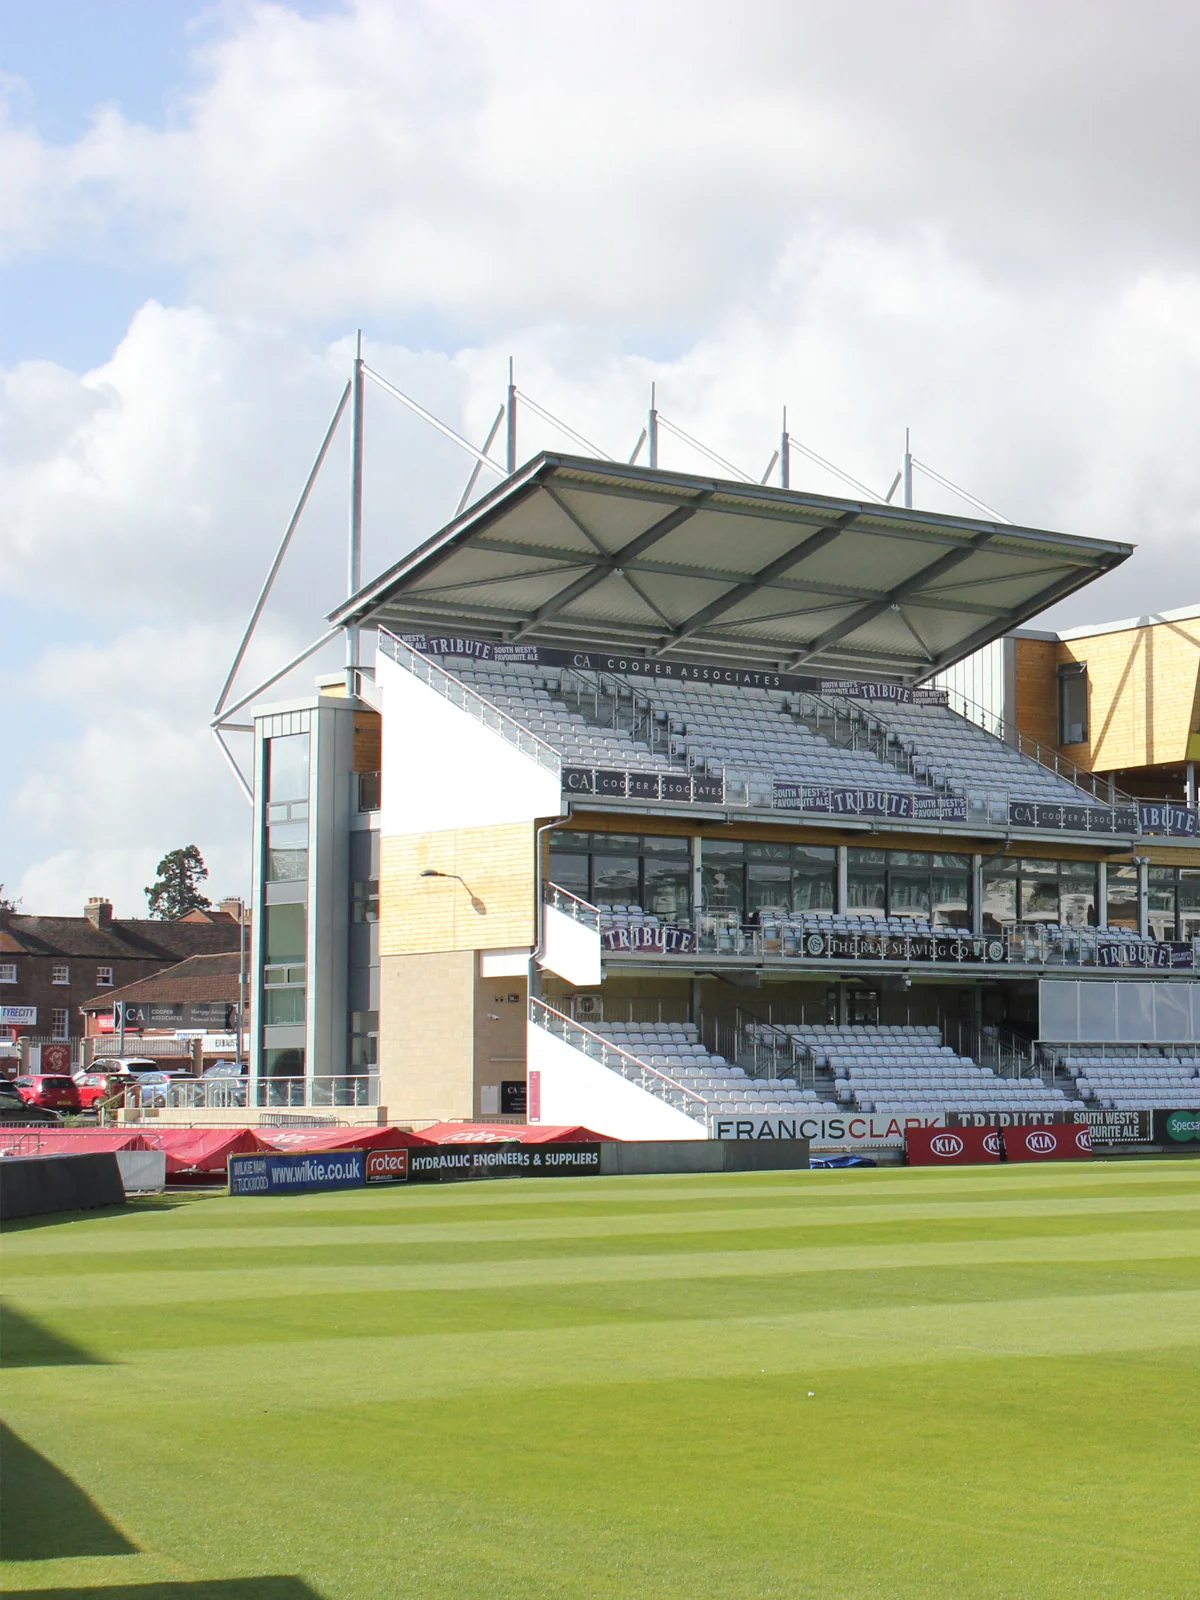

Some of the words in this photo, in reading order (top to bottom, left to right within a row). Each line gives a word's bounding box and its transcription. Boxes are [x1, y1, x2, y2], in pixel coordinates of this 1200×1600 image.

[415, 641, 428, 650] ALE
[429, 638, 491, 660] TRIBUTE
[494, 653, 526, 661] FAVOURITE
[573, 654, 592, 668] CA
[607, 659, 672, 675] COOPER
[680, 667, 780, 686] ASSOCIATES
[861, 684, 910, 703] TRIBUTE
[568, 773, 590, 789] CA
[602, 779, 649, 790] COOPER
[652, 783, 722, 796] ASSOCIATES
[773, 788, 797, 798] SOUTH
[797, 787, 828, 797] WEST'S
[815, 797, 830, 806] ALE
[834, 791, 909, 816] TRIBUTE
[914, 800, 937, 809] SOUTH
[953, 807, 966, 816] ALE
[1014, 807, 1032, 821] CA
[1042, 812, 1079, 823] COOPER
[1081, 816, 1137, 826] ASSOCATES
[1143, 807, 1196, 833] IBUTE
[605, 926, 692, 951] TRIBUTE
[830, 940, 856, 953] THE
[860, 941, 890, 954] REAL
[892, 941, 947, 956] SHAVING
[1100, 945, 1167, 966] TRIBUTE
[125, 1008, 146, 1021] CA
[1073, 1112, 1104, 1125] SOUTH
[1105, 1111, 1140, 1125] WEST'S
[1088, 1125, 1121, 1138] OURITE
[1122, 1125, 1140, 1137] ALE
[935, 1139, 959, 1152] KIA
[1030, 1136, 1052, 1149] KIA
[370, 1154, 405, 1171] rotec
[412, 1154, 471, 1171] HYDRAULIC
[473, 1152, 530, 1167] ENGINEERS
[533, 1154, 542, 1166] &
[545, 1152, 598, 1166] SUPPLIERS
[271, 1158, 360, 1184] www.wilkie.co.uk
